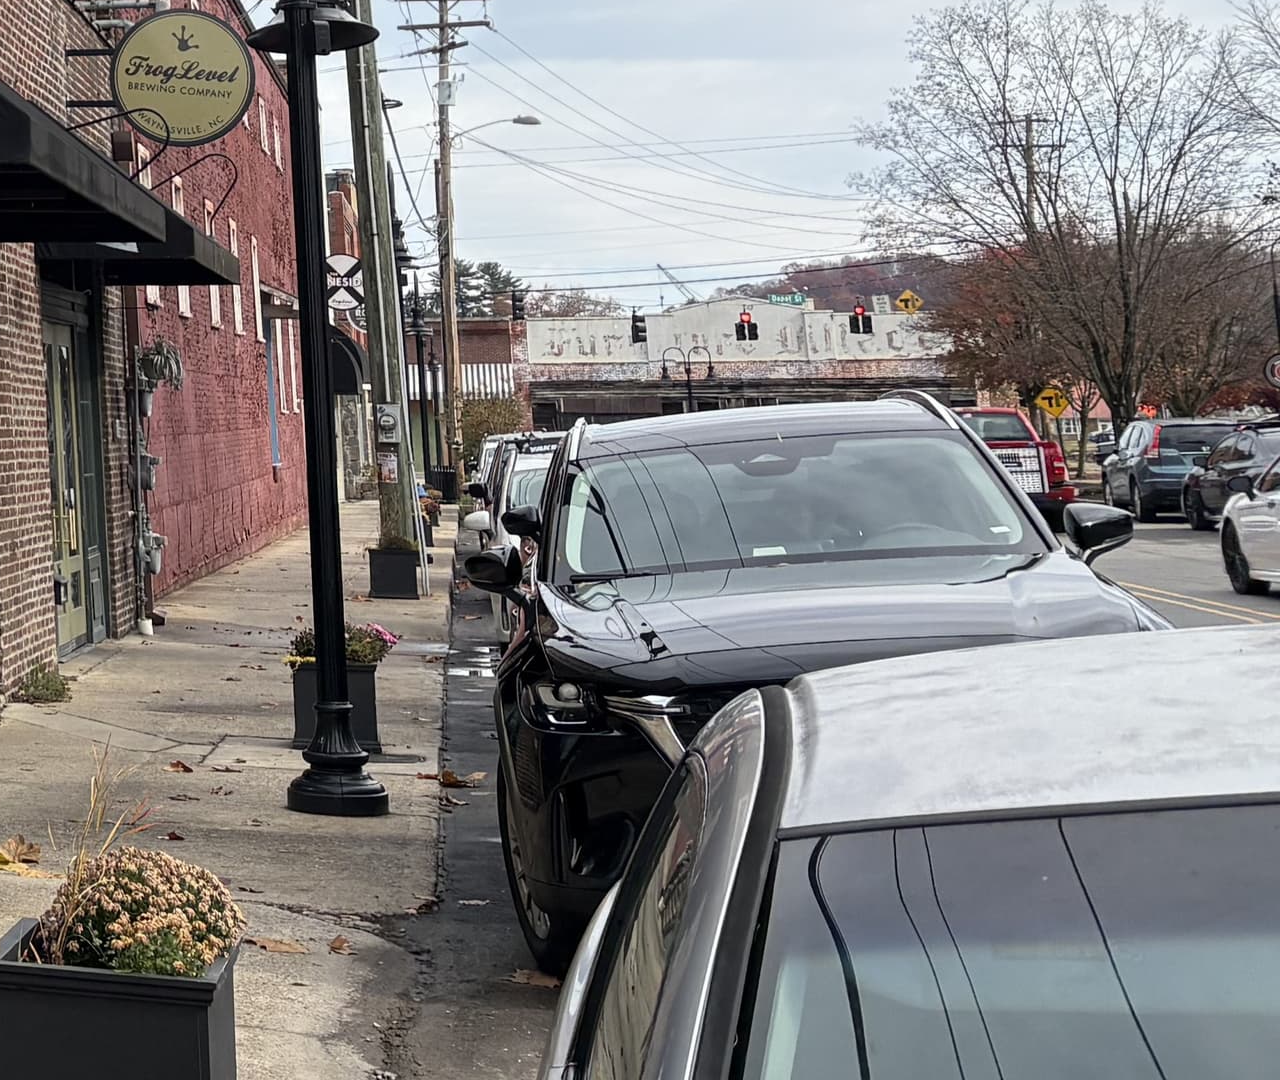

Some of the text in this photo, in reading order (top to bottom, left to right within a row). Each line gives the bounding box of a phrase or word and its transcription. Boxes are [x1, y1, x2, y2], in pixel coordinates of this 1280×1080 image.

[125, 55, 240, 85] Frog Level
[128, 81, 233, 99] BREWING COMPANY
[207, 115, 226, 129] NC
